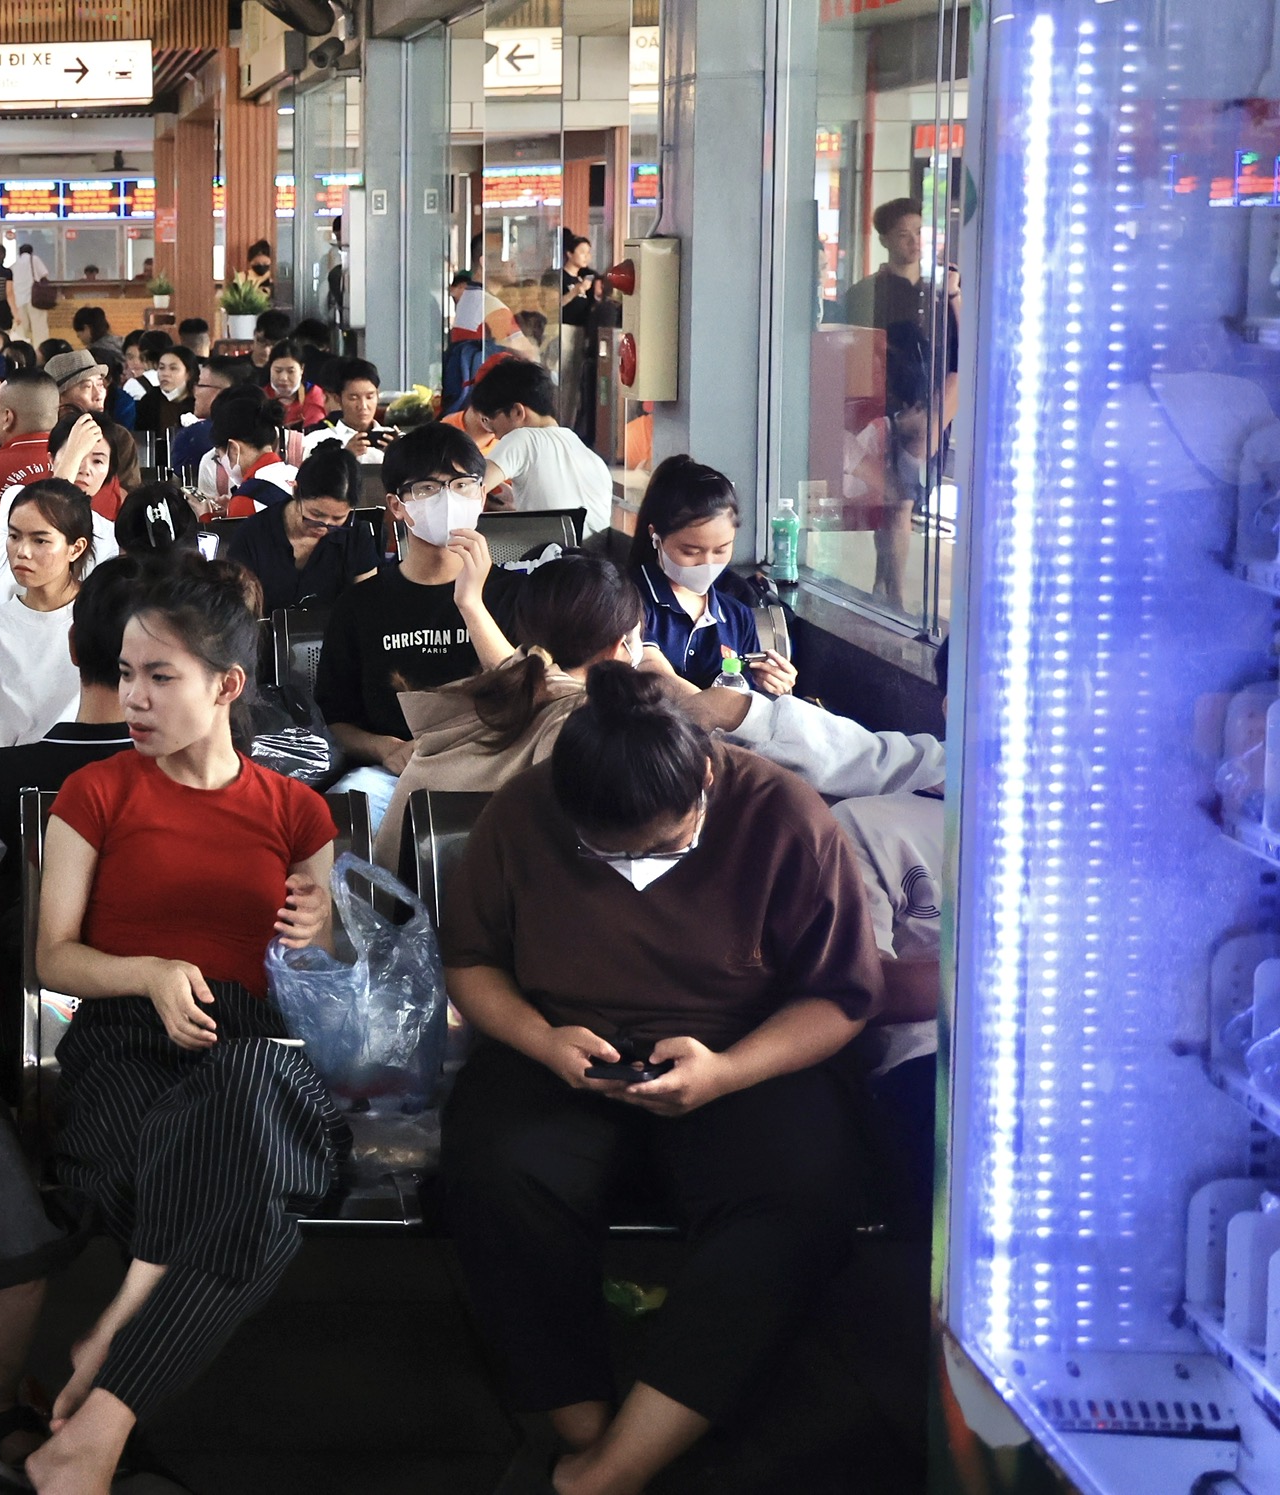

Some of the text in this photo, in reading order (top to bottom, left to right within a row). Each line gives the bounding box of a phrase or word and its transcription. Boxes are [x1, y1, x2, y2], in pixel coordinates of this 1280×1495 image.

[9, 53, 25, 66] ĐI
[33, 53, 52, 65] XE
[382, 628, 470, 651] CHRISTIAN DI
